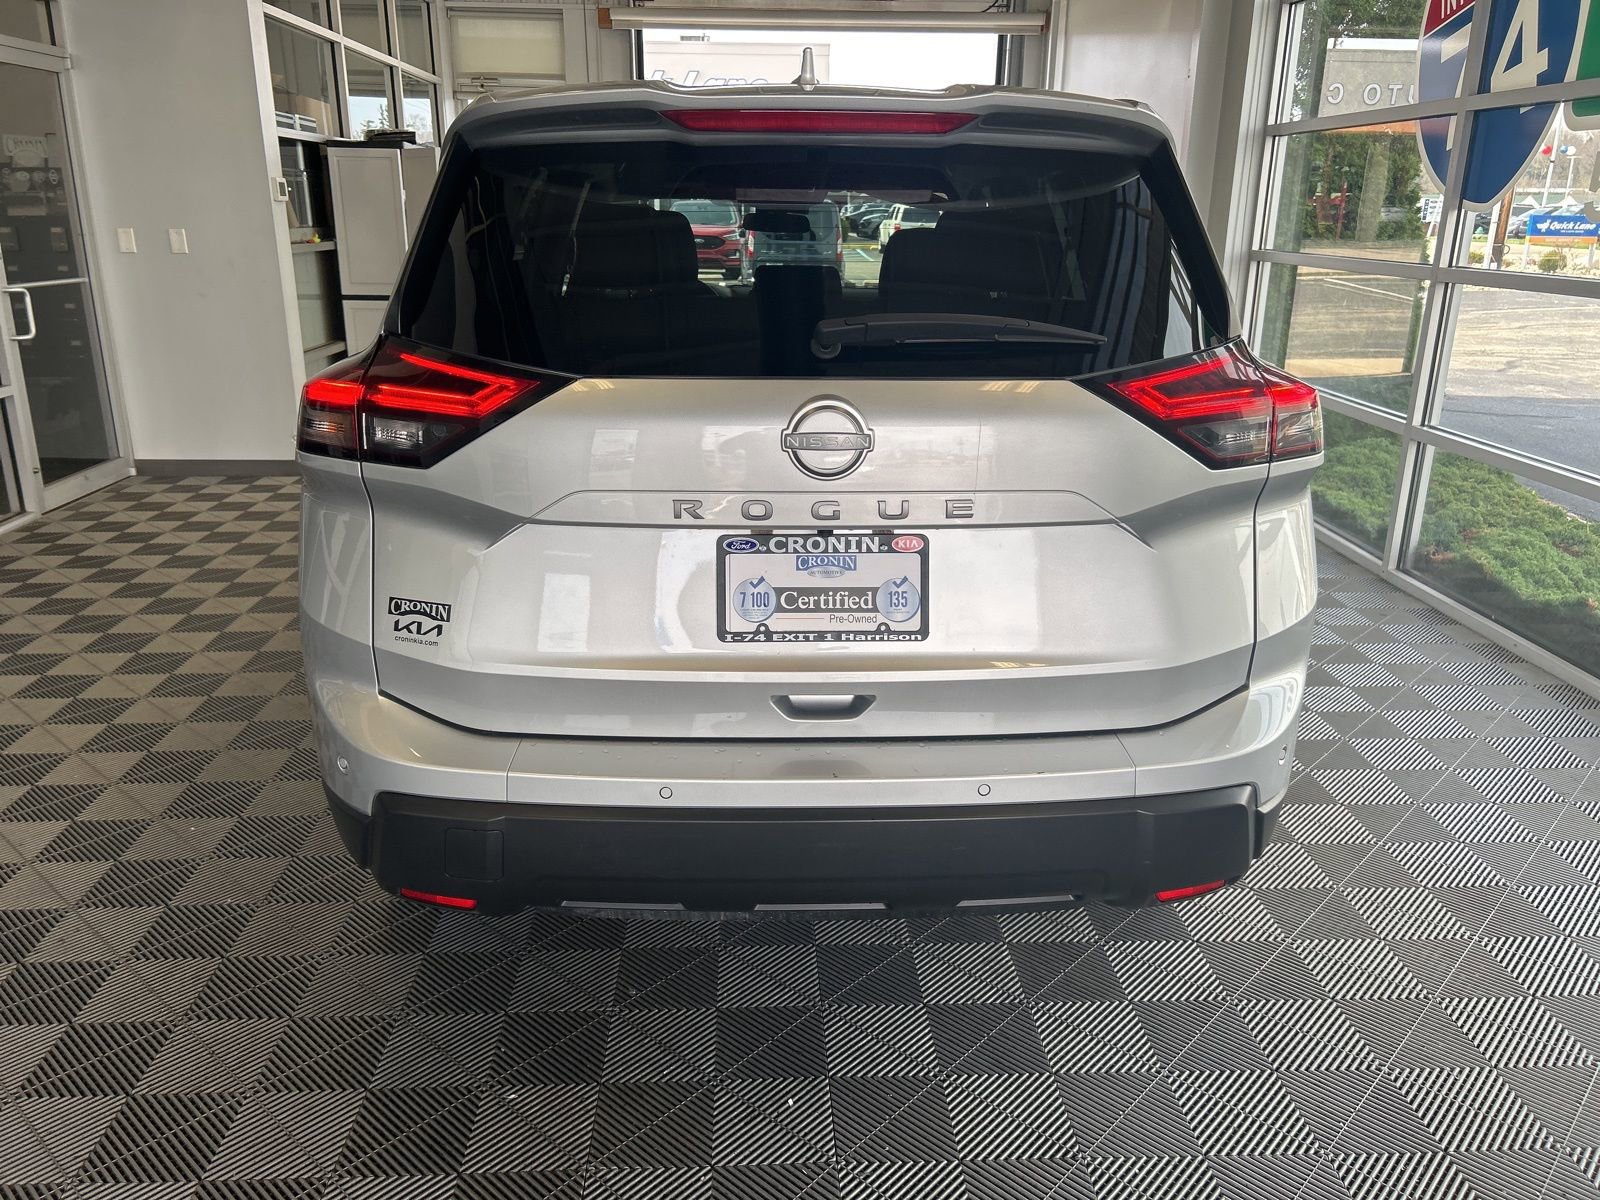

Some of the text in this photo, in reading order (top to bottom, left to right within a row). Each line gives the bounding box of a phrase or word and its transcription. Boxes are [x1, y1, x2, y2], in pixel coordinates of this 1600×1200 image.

[1549, 221, 1597, 230] Quick Lane
[786, 436, 872, 448] NISSAN
[672, 499, 975, 521] ROGUE
[768, 536, 880, 553] CRONIN
[798, 556, 856, 569] CRONIN
[750, 591, 770, 608] 100
[780, 591, 874, 610] Certified
[888, 590, 908, 608] 135
[390, 598, 449, 621] CRONIN
[829, 614, 878, 624] Pre-Owned
[394, 635, 439, 647] croninkia.com
[724, 632, 922, 642] I-74 EXIT 1 Harrison
